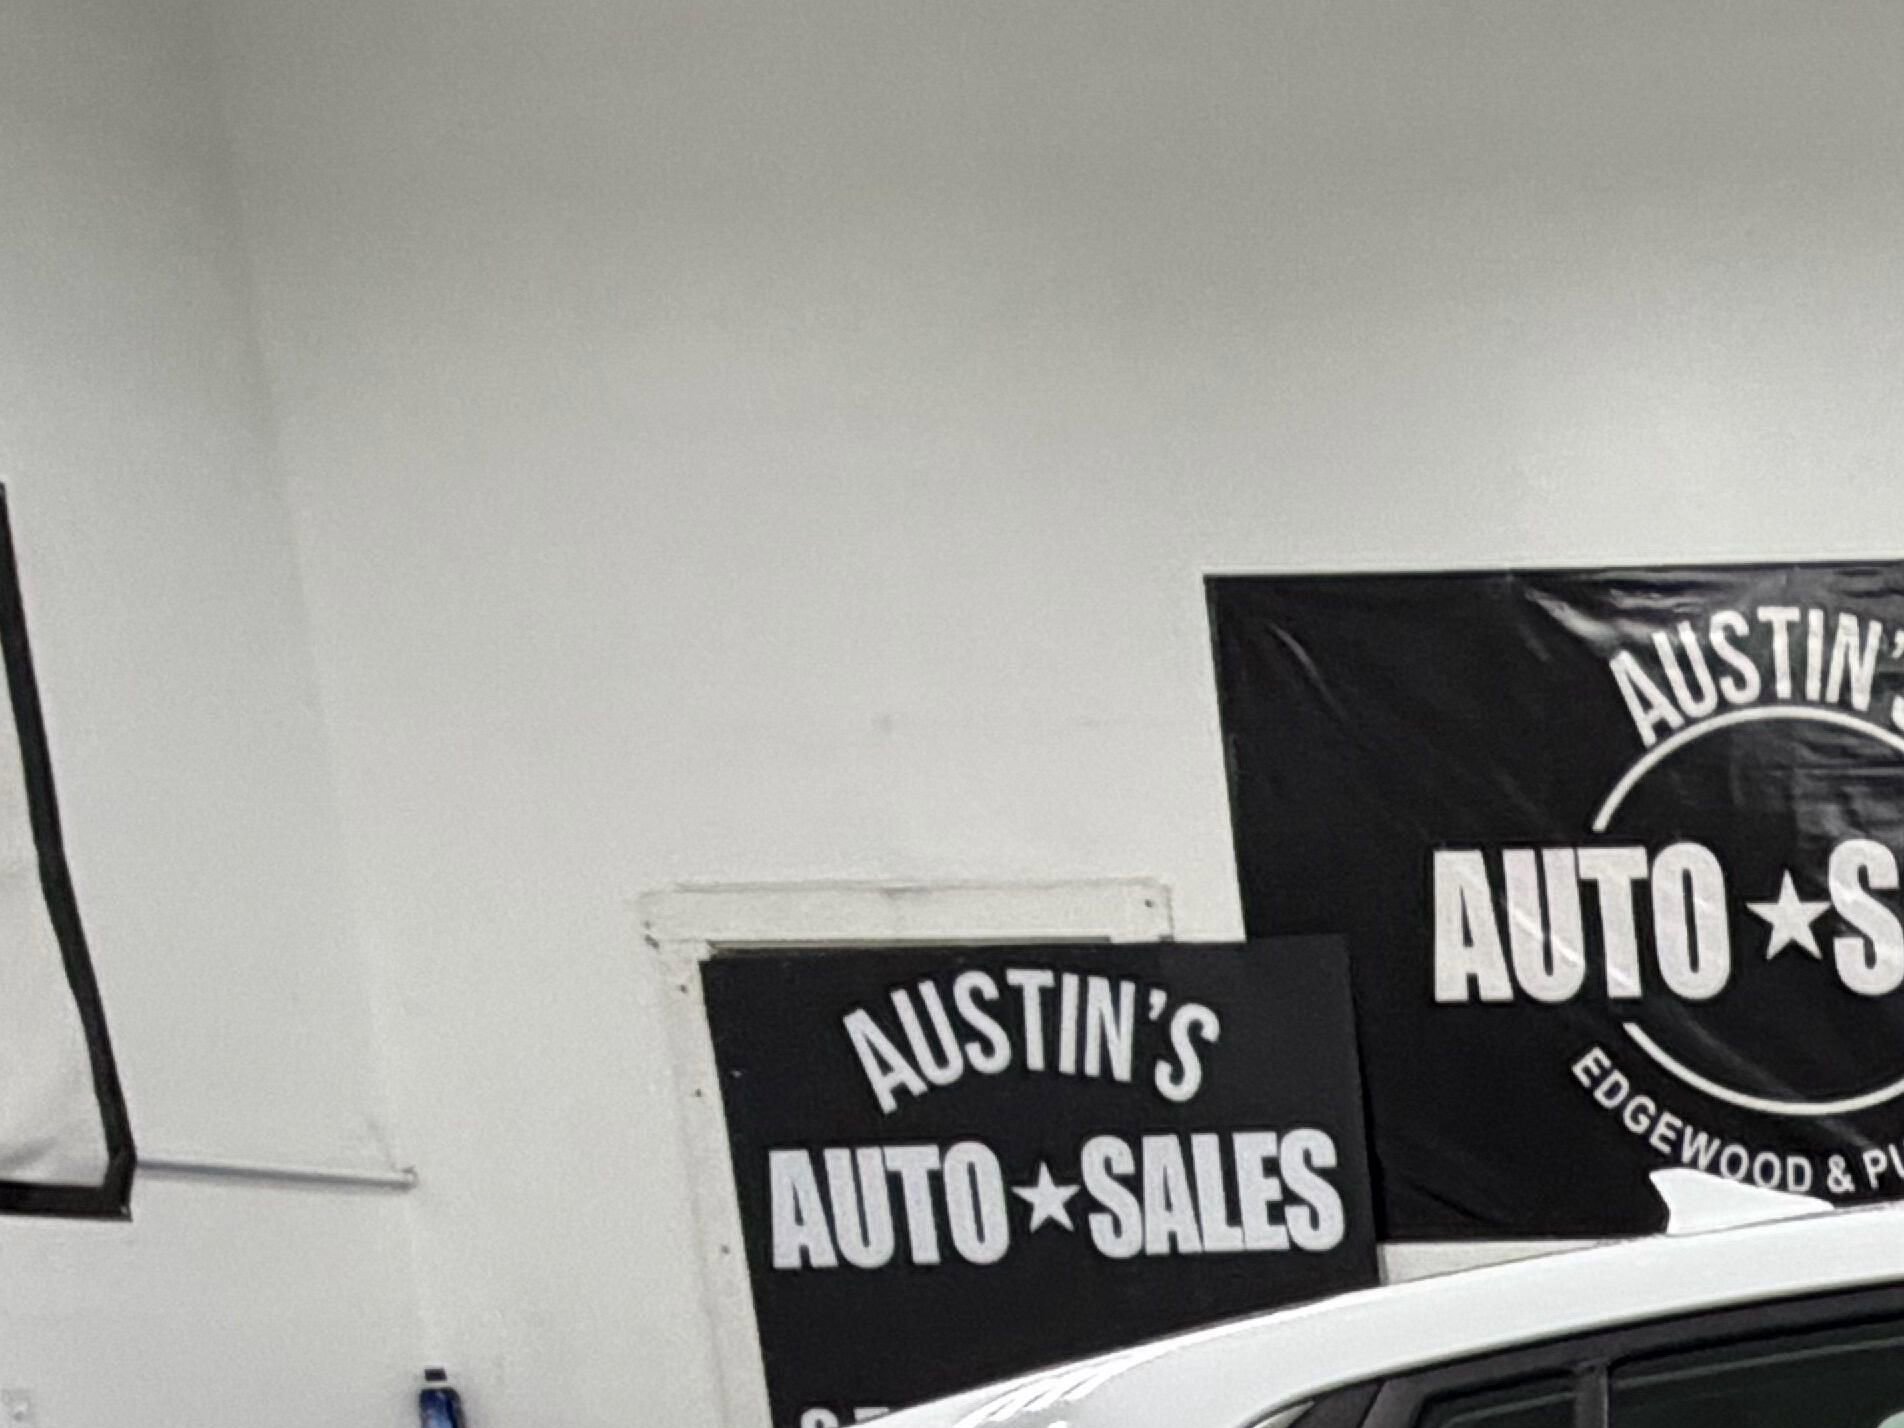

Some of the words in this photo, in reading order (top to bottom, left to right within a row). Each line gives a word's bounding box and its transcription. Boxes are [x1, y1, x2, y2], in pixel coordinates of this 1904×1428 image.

[1433, 842, 1732, 1003] AUTO
[843, 968, 1220, 1113] AUSTIN'S
[1571, 1047, 1814, 1193] EDGEWOOD
[1827, 1154, 1856, 1194] &
[768, 1141, 1011, 1269] AUTO
[1081, 1129, 1344, 1260] SALES
